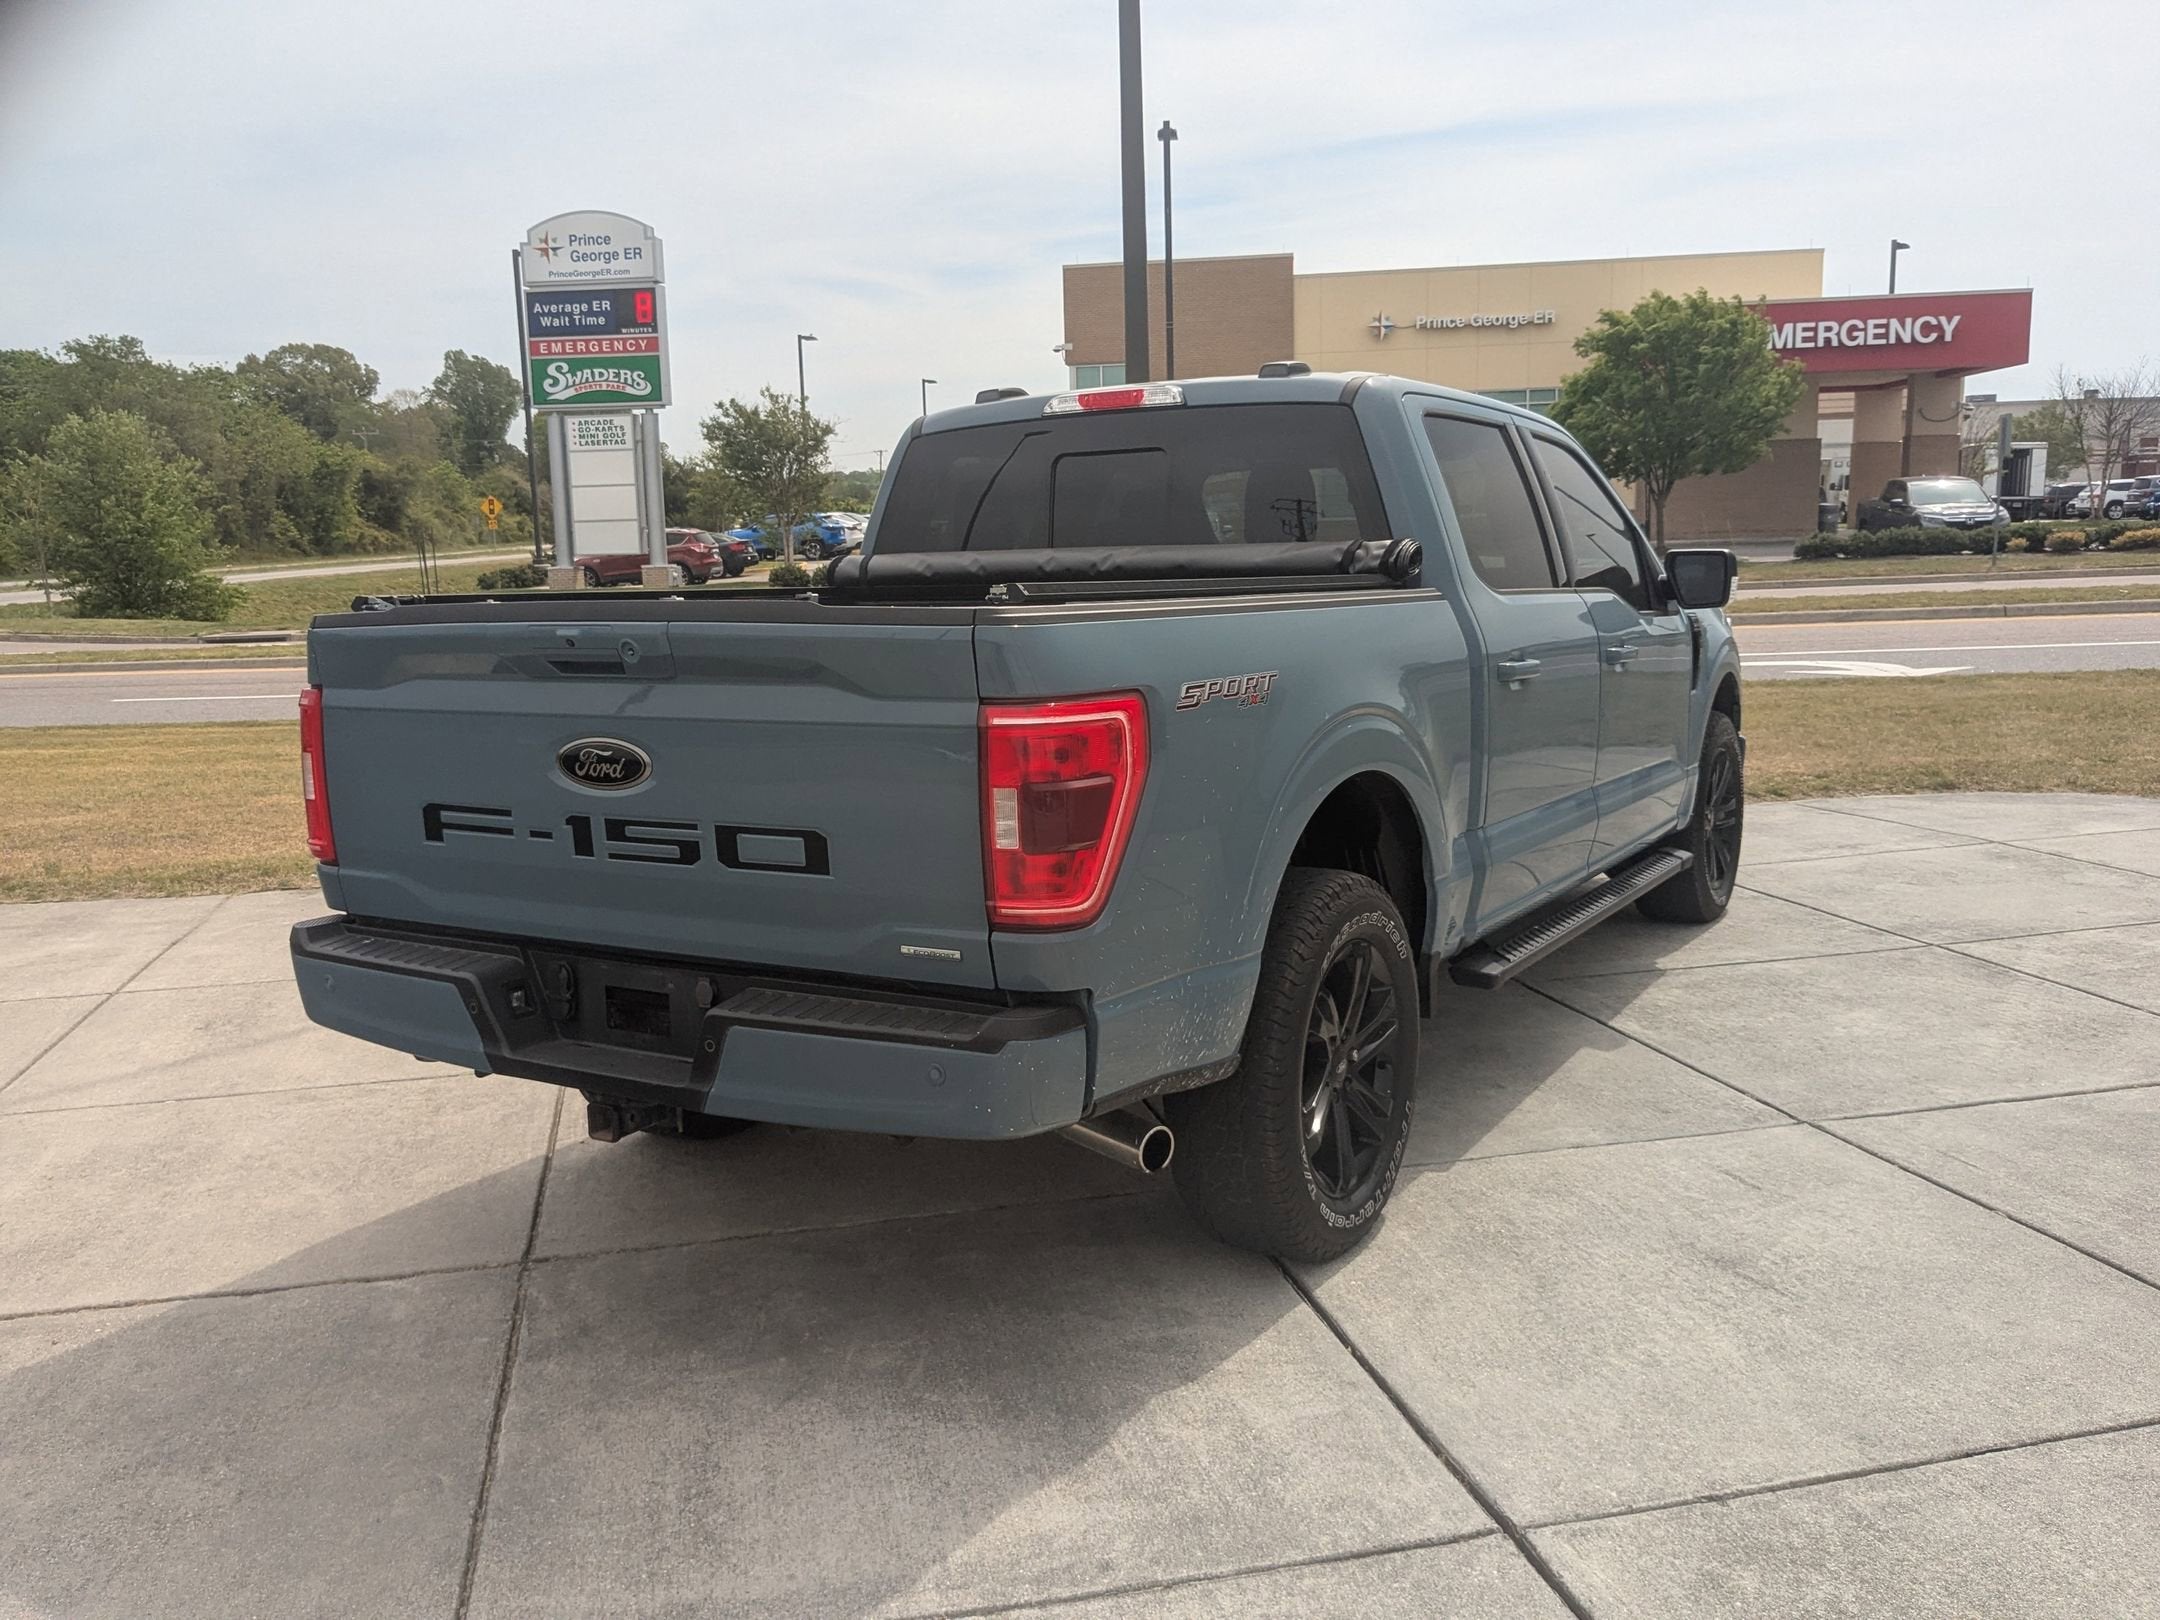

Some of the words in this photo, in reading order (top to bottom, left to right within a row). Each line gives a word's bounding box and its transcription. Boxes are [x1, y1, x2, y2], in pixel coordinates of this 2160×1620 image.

[569, 234, 612, 247] Prince
[570, 249, 620, 264] George
[624, 247, 643, 260] ER
[548, 268, 631, 279] PrinceGeorgeER.com
[533, 302, 589, 315] Average
[592, 300, 611, 312] ER
[634, 290, 653, 324] 8
[540, 316, 570, 327] Wait
[573, 314, 606, 326] Time
[1415, 315, 1465, 329] Prince
[1470, 313, 1529, 329] George
[1533, 310, 1556, 324] ER
[1768, 315, 1961, 350] MERGENCY
[540, 339, 648, 354] EMERGENCY
[574, 384, 603, 393] SPORTS
[606, 383, 627, 391] PARK
[578, 419, 615, 427] ARCADE
[578, 425, 625, 433] GO-KARTS
[579, 439, 627, 447] LASERTAG
[1176, 671, 1279, 712] SPORT
[575, 748, 625, 778] Ford
[422, 803, 830, 876] F-150
